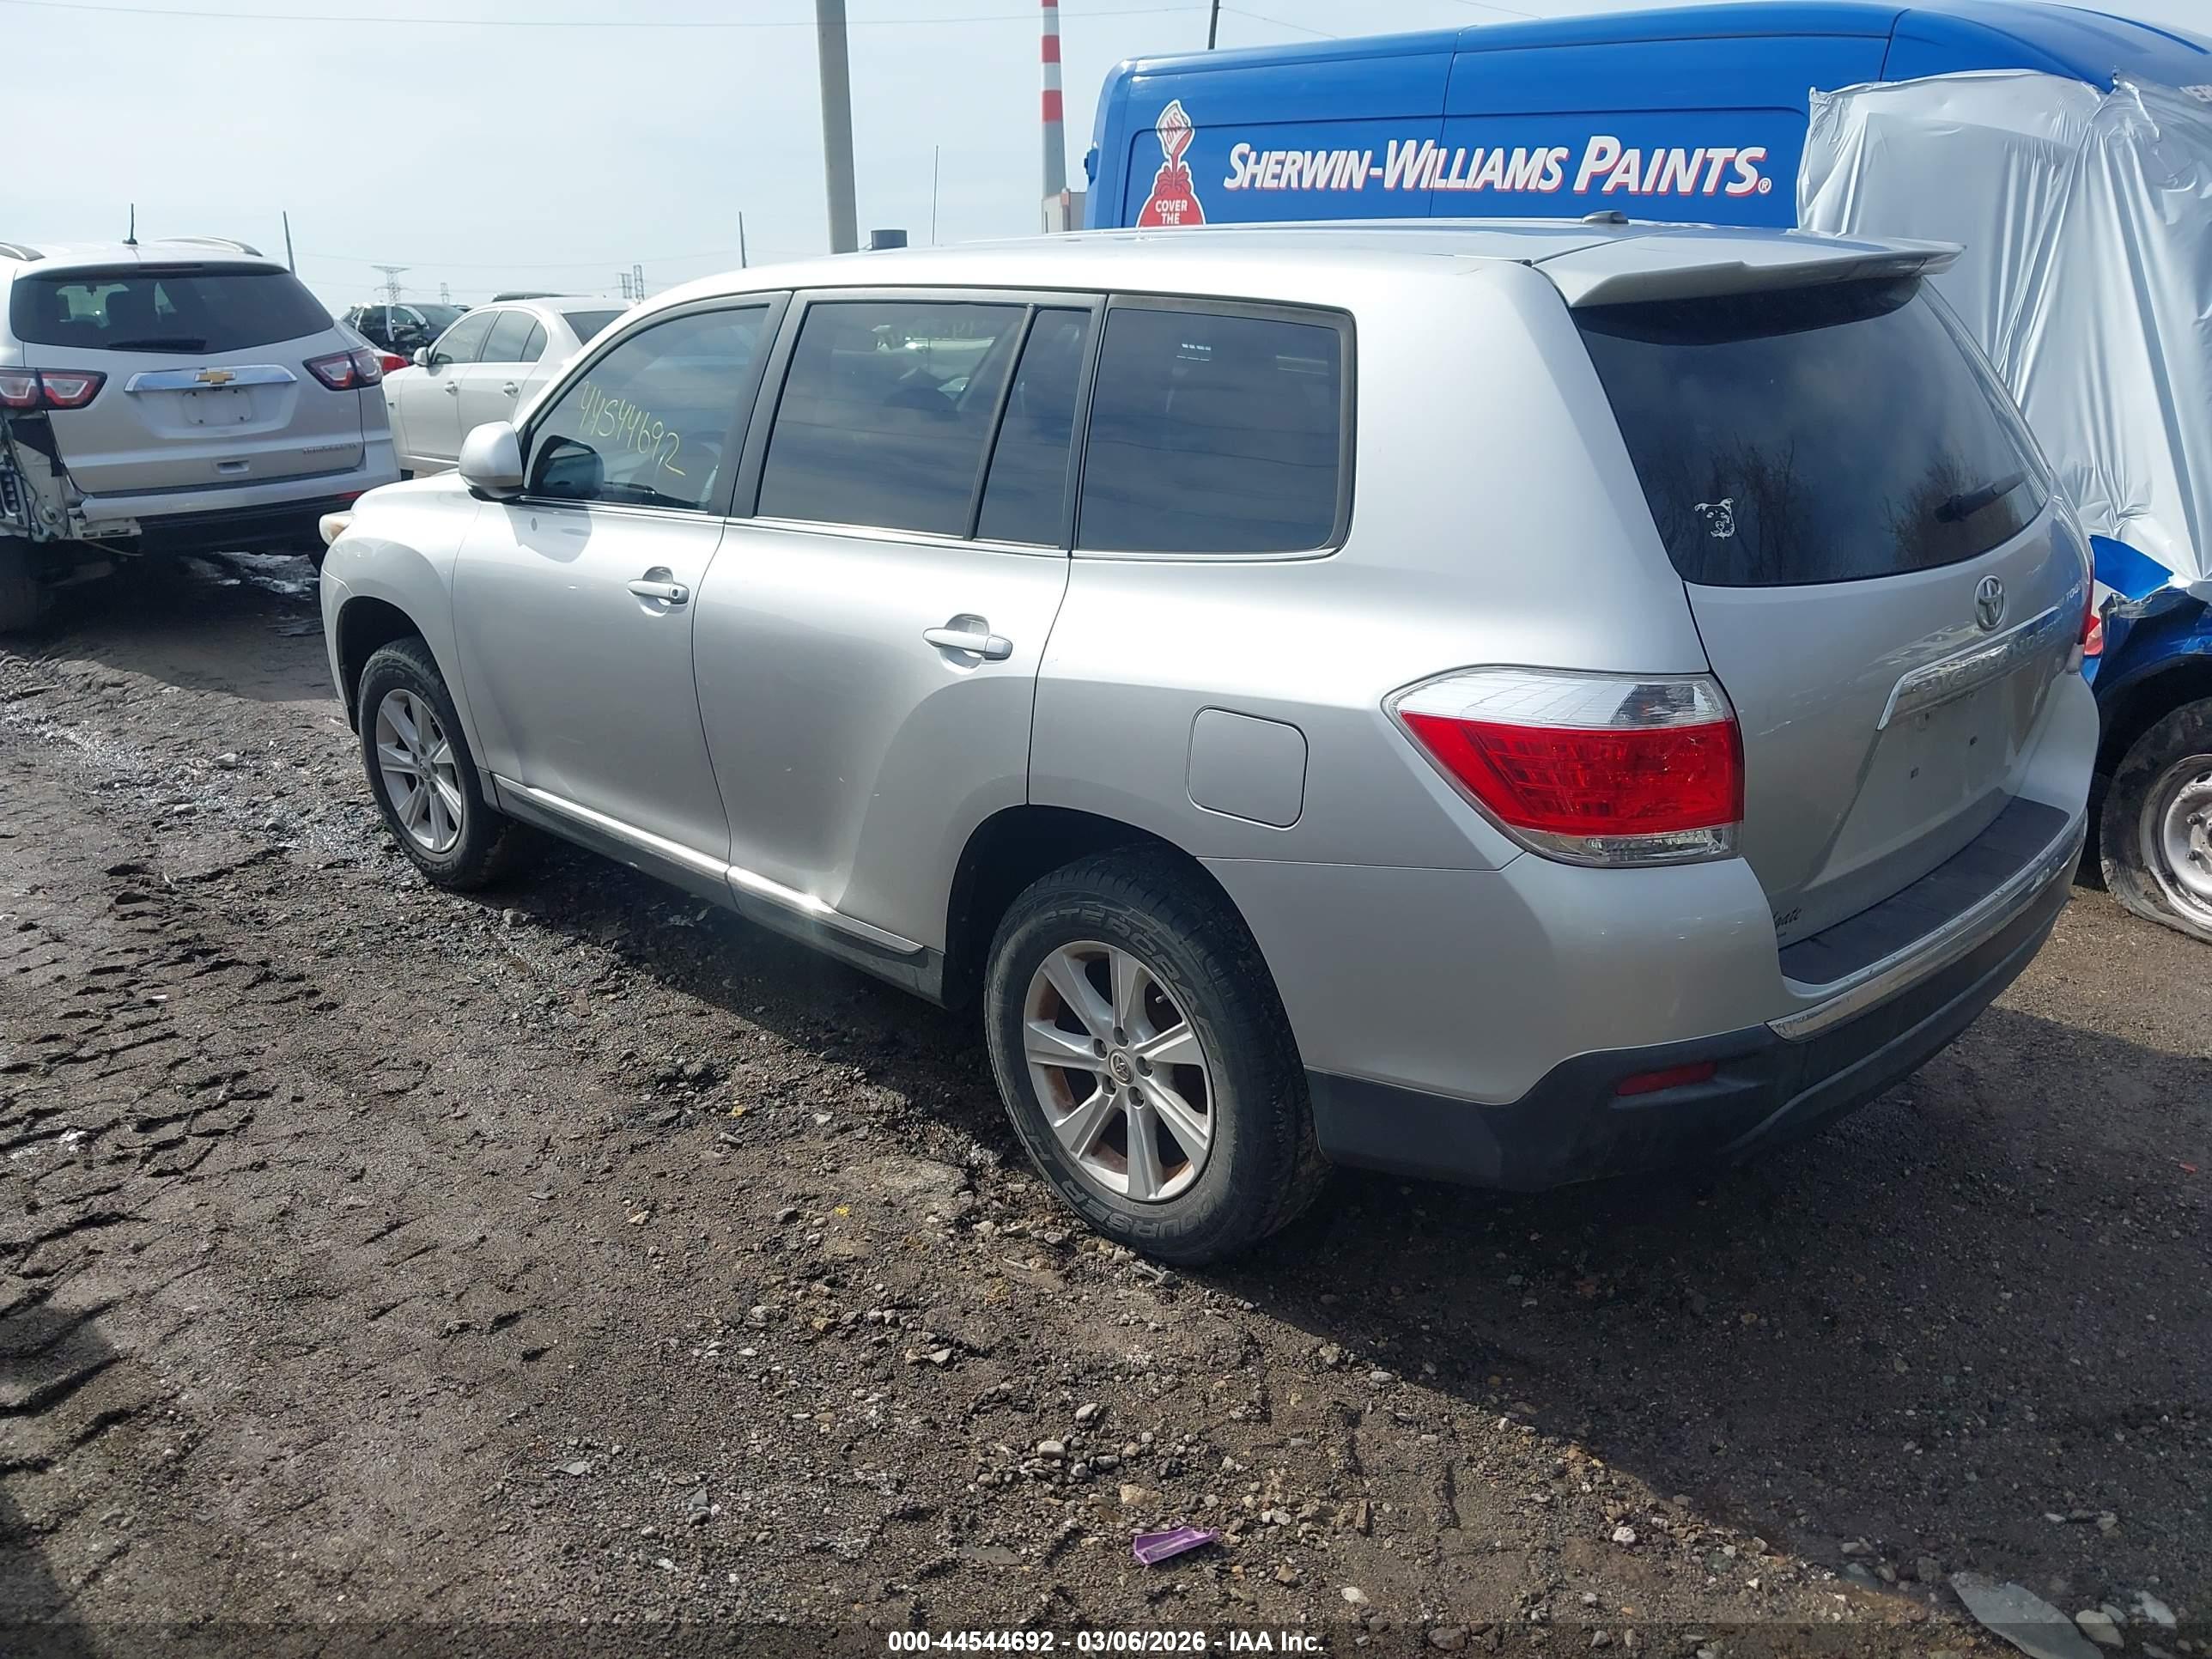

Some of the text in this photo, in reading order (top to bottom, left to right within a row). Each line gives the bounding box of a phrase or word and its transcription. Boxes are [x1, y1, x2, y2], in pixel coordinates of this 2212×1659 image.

[1223, 139, 1570, 192] SHERWIN-WILLIAMS
[1155, 199, 1188, 212] COVER
[1161, 212, 1181, 225] THE
[579, 380, 686, 476] 44544692
